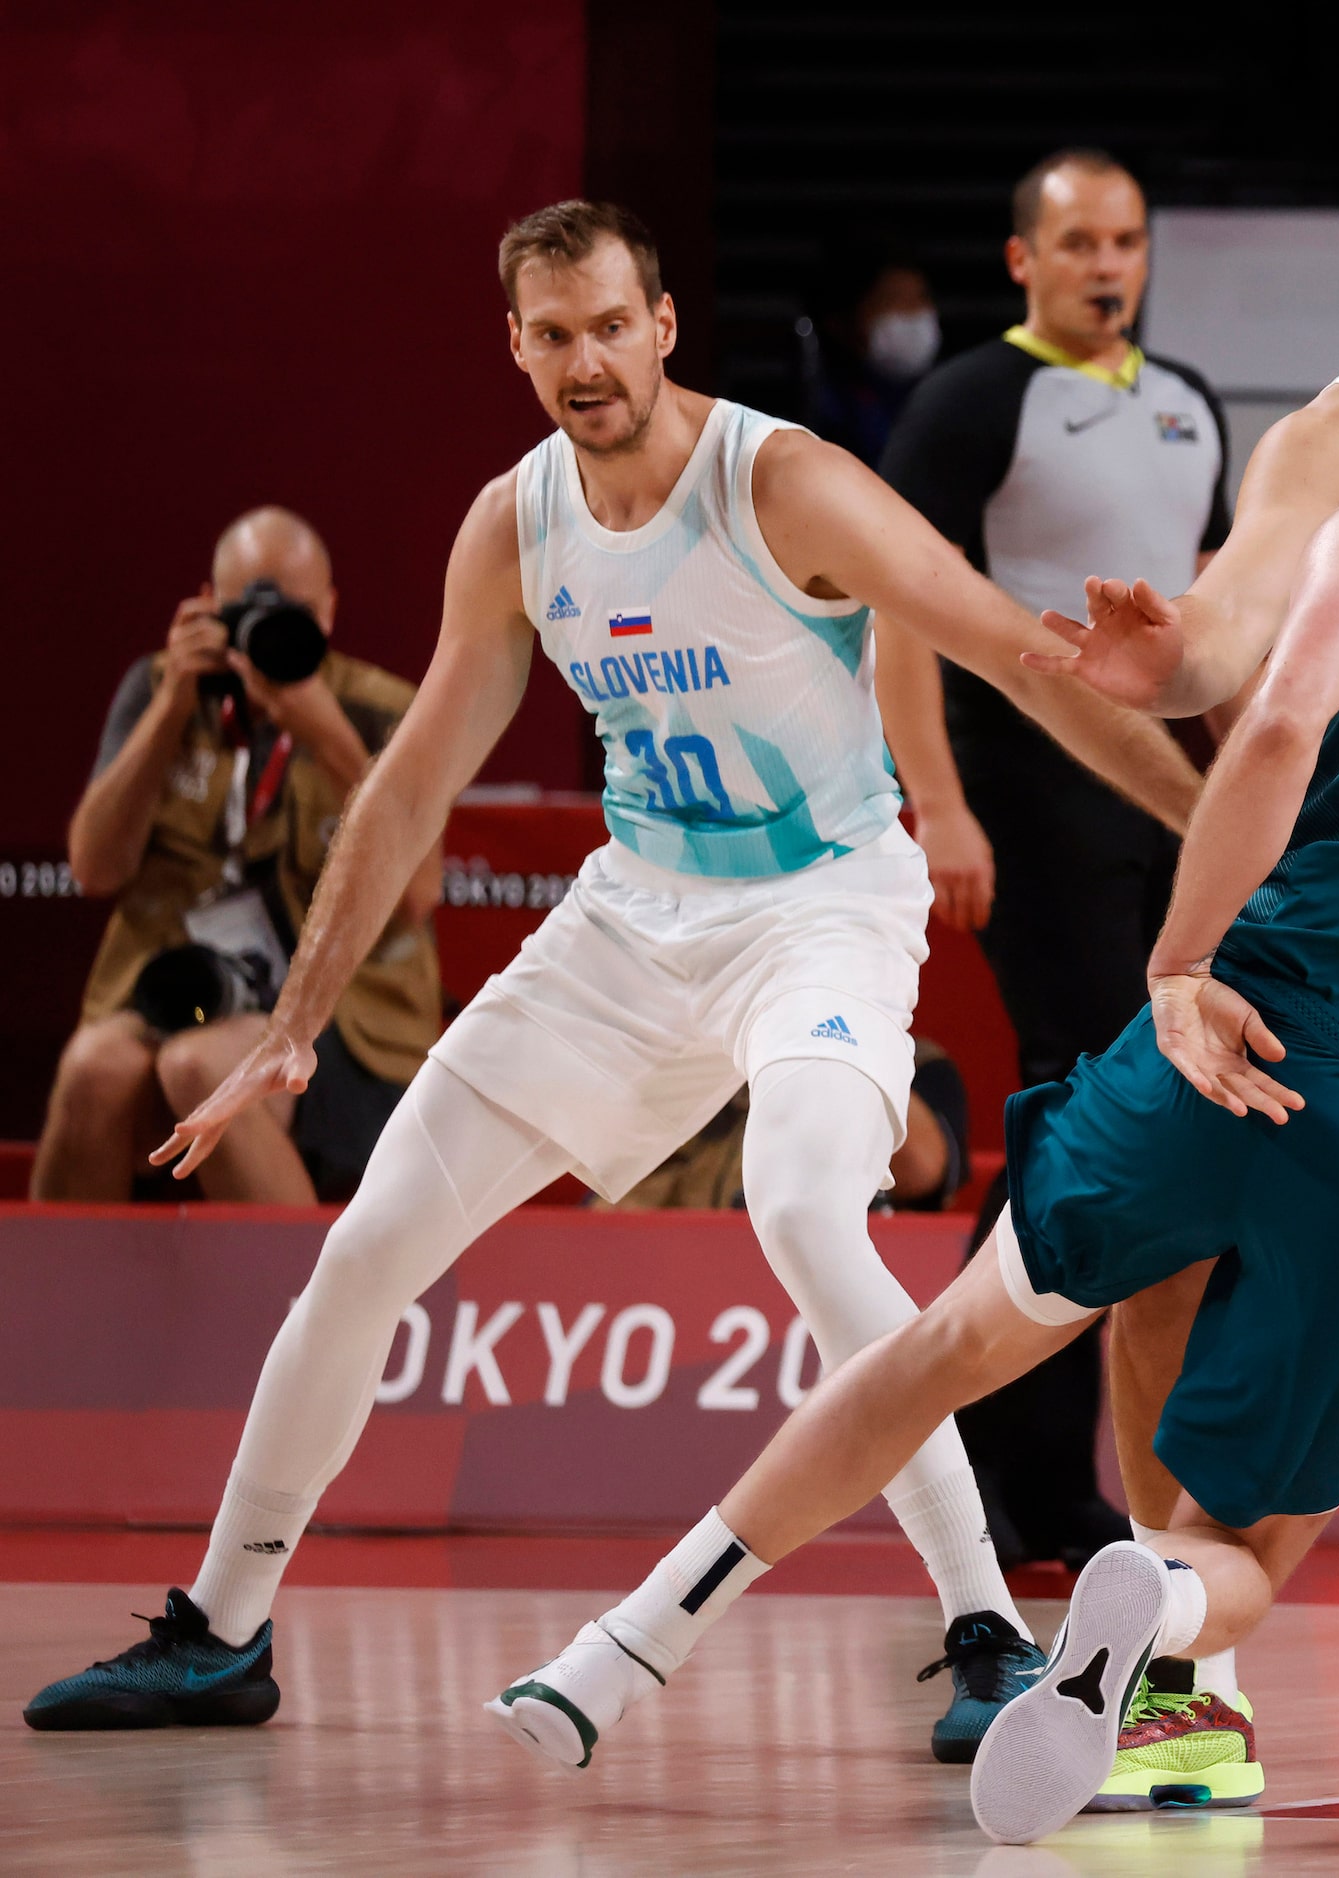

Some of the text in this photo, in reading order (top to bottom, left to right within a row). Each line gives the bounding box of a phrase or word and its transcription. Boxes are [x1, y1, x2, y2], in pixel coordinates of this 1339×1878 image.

[546, 607, 581, 621] adidas
[569, 645, 731, 701] SLOVENIA
[624, 729, 736, 819] 30
[810, 1028, 858, 1046] adidas
[374, 1301, 676, 1408] OKYO
